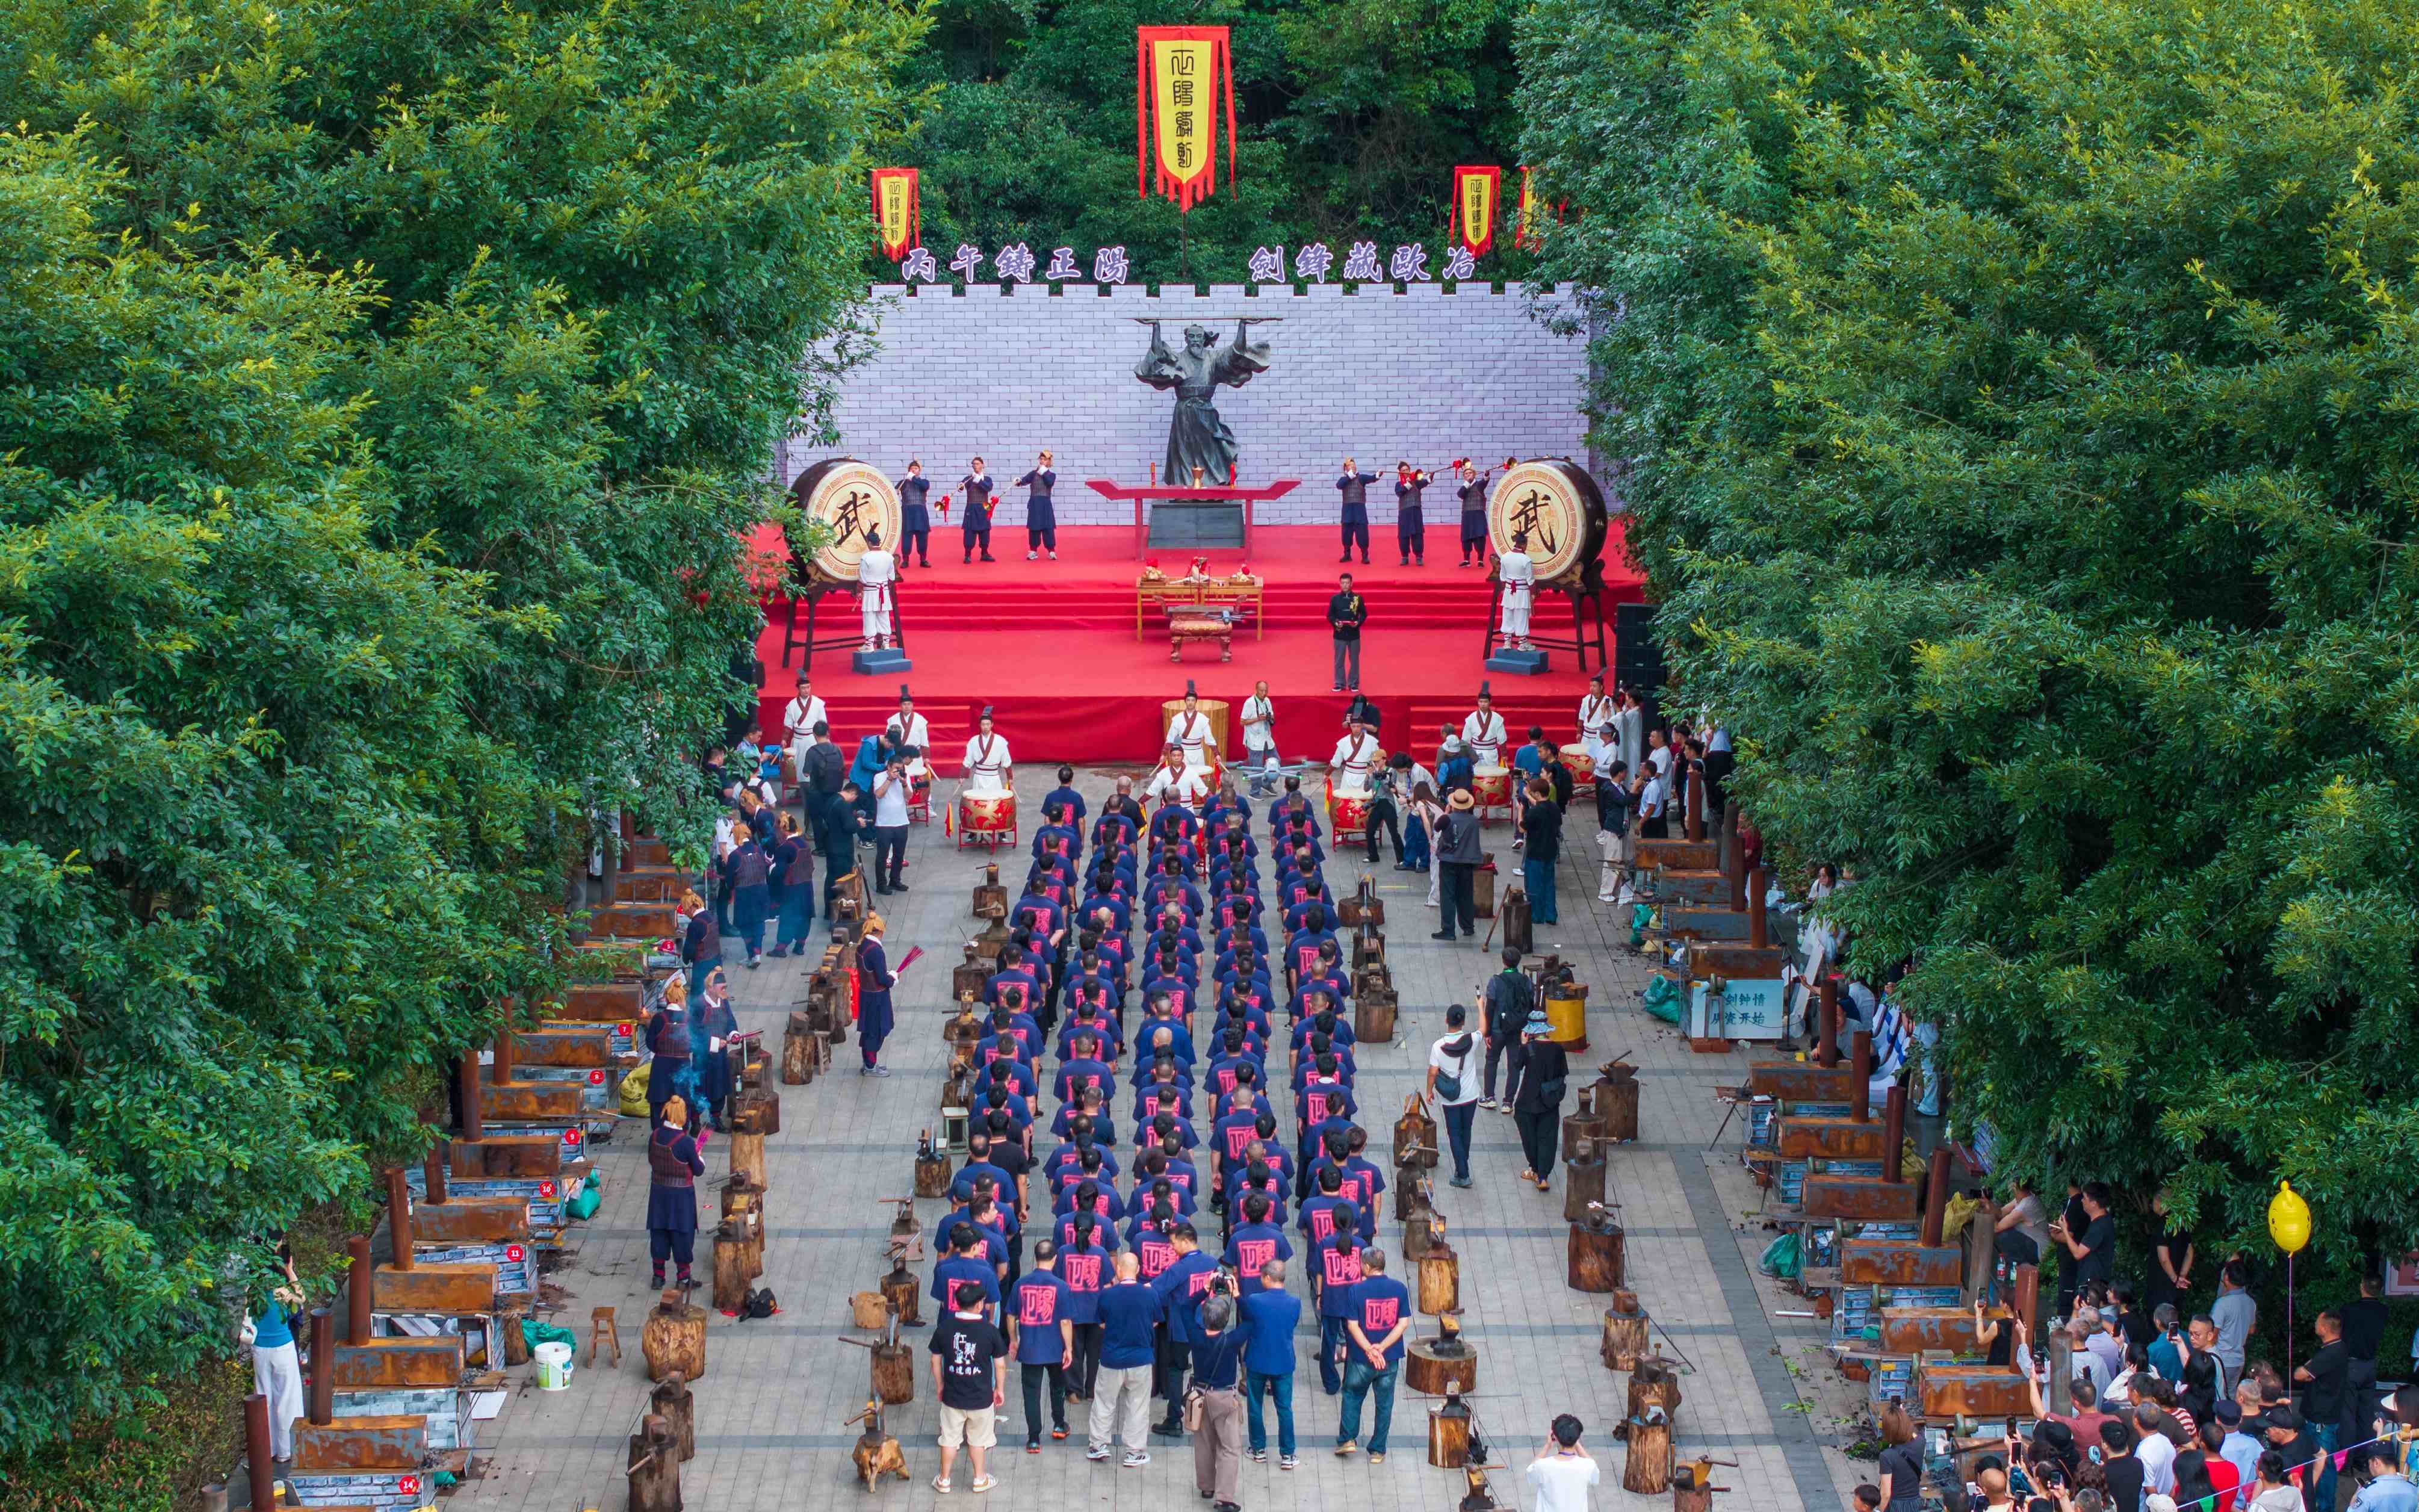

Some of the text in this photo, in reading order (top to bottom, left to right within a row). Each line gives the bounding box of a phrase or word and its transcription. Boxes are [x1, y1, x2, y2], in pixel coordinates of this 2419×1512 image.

[902, 242, 1129, 284] 丙午鑄正陽
[833, 491, 869, 548] 武
[1509, 489, 1556, 554] 武
[1725, 994, 1766, 1006] 剑钟情
[404, 1481, 413, 1489] 14
